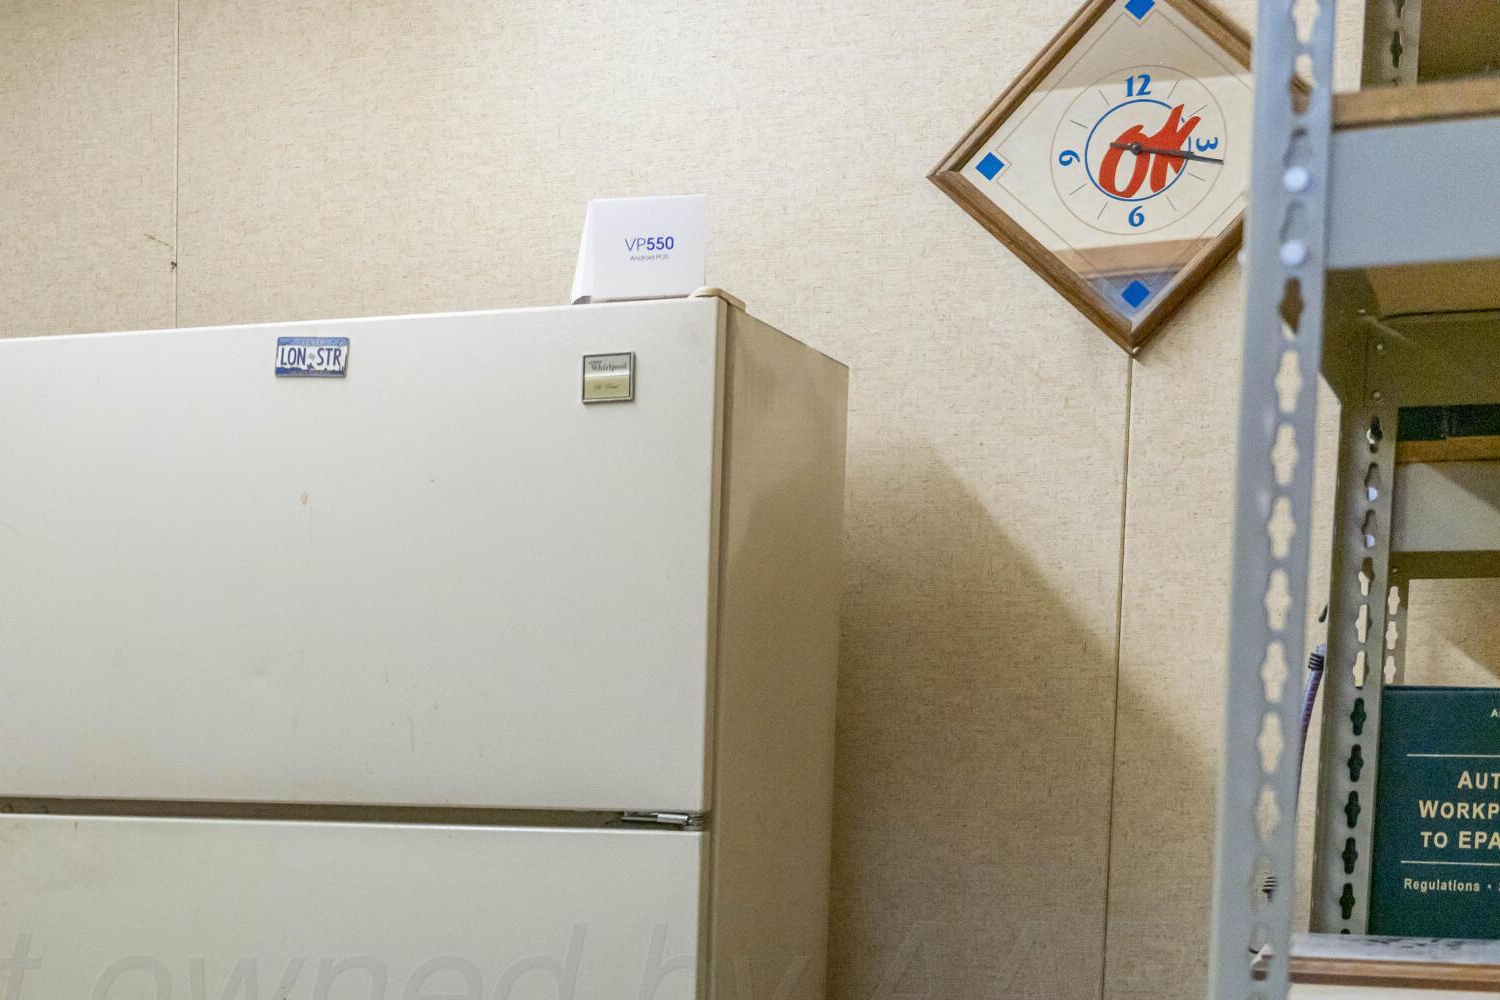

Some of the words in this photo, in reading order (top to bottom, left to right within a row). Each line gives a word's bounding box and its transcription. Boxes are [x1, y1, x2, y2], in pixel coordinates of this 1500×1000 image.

[1125, 74, 1153, 98] 12
[1098, 103, 1203, 199] OK
[1195, 136, 1219, 151] 3
[1127, 205, 1146, 228] 6
[624, 235, 675, 253] VP550
[629, 253, 656, 262] Android
[280, 347, 307, 366] LON
[316, 347, 342, 367] STR
[591, 362, 628, 373] Whirlpool
[1418, 799, 1500, 820] WORKP
[1420, 830, 1449, 849] TO
[1458, 830, 1500, 850] EPA
[1403, 877, 1481, 893] Regulations
